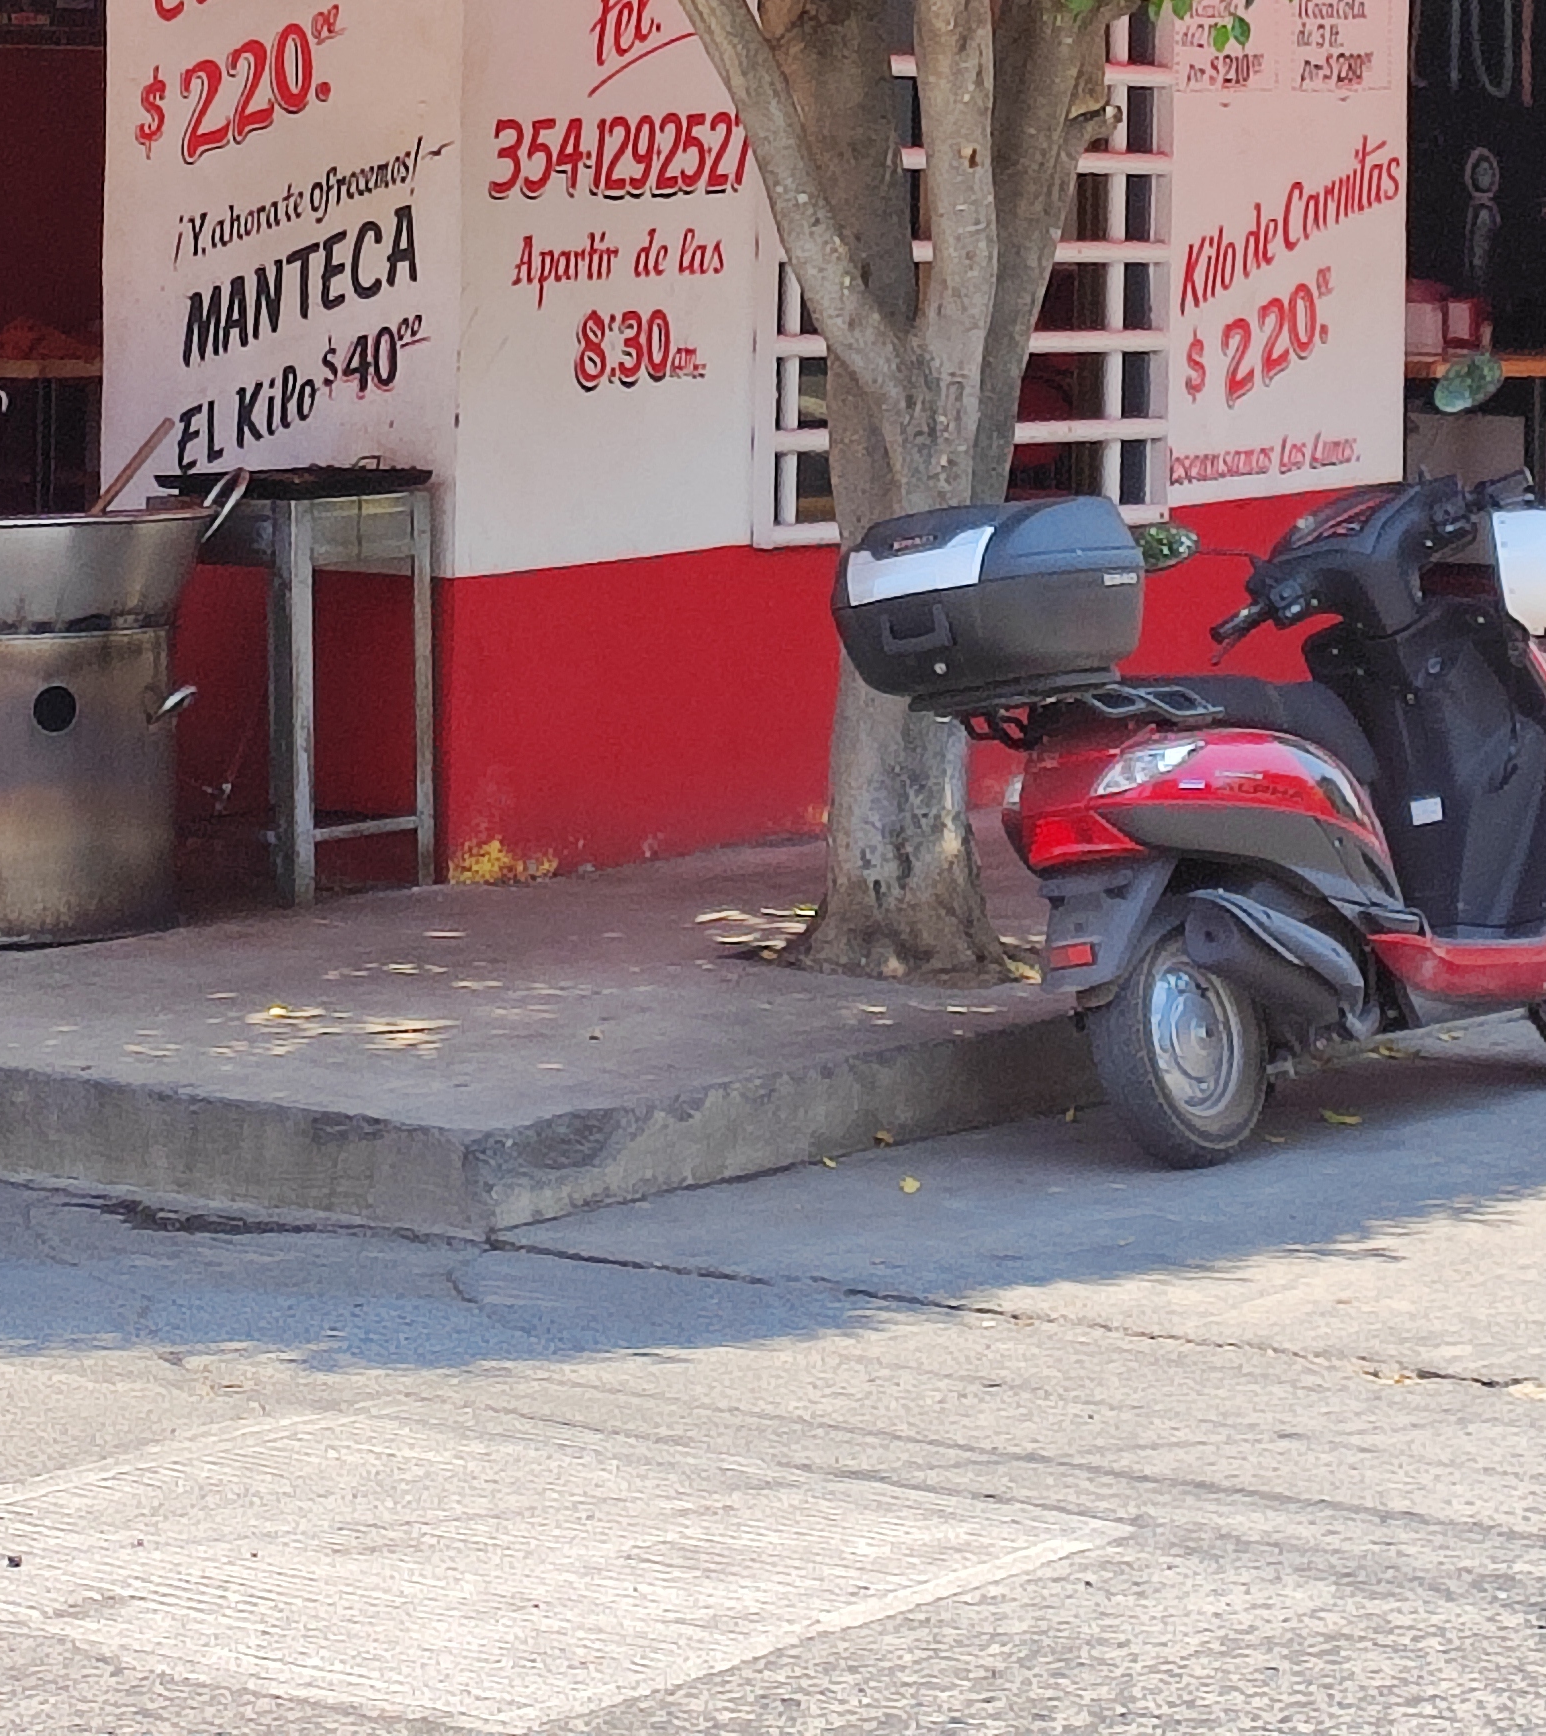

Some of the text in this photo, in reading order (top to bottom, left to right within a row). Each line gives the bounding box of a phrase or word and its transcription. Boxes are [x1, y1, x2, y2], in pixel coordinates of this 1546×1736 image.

[1315, 24, 1326, 47] 3
[634, 227, 668, 278] de
[678, 228, 725, 275] las
[1180, 225, 1236, 316] Kilo
[1243, 203, 1278, 279] de
[1282, 135, 1400, 252] Carnitas
[182, 204, 418, 368] MANTECA
[177, 400, 224, 474] EL
[236, 365, 317, 449] Kilo
